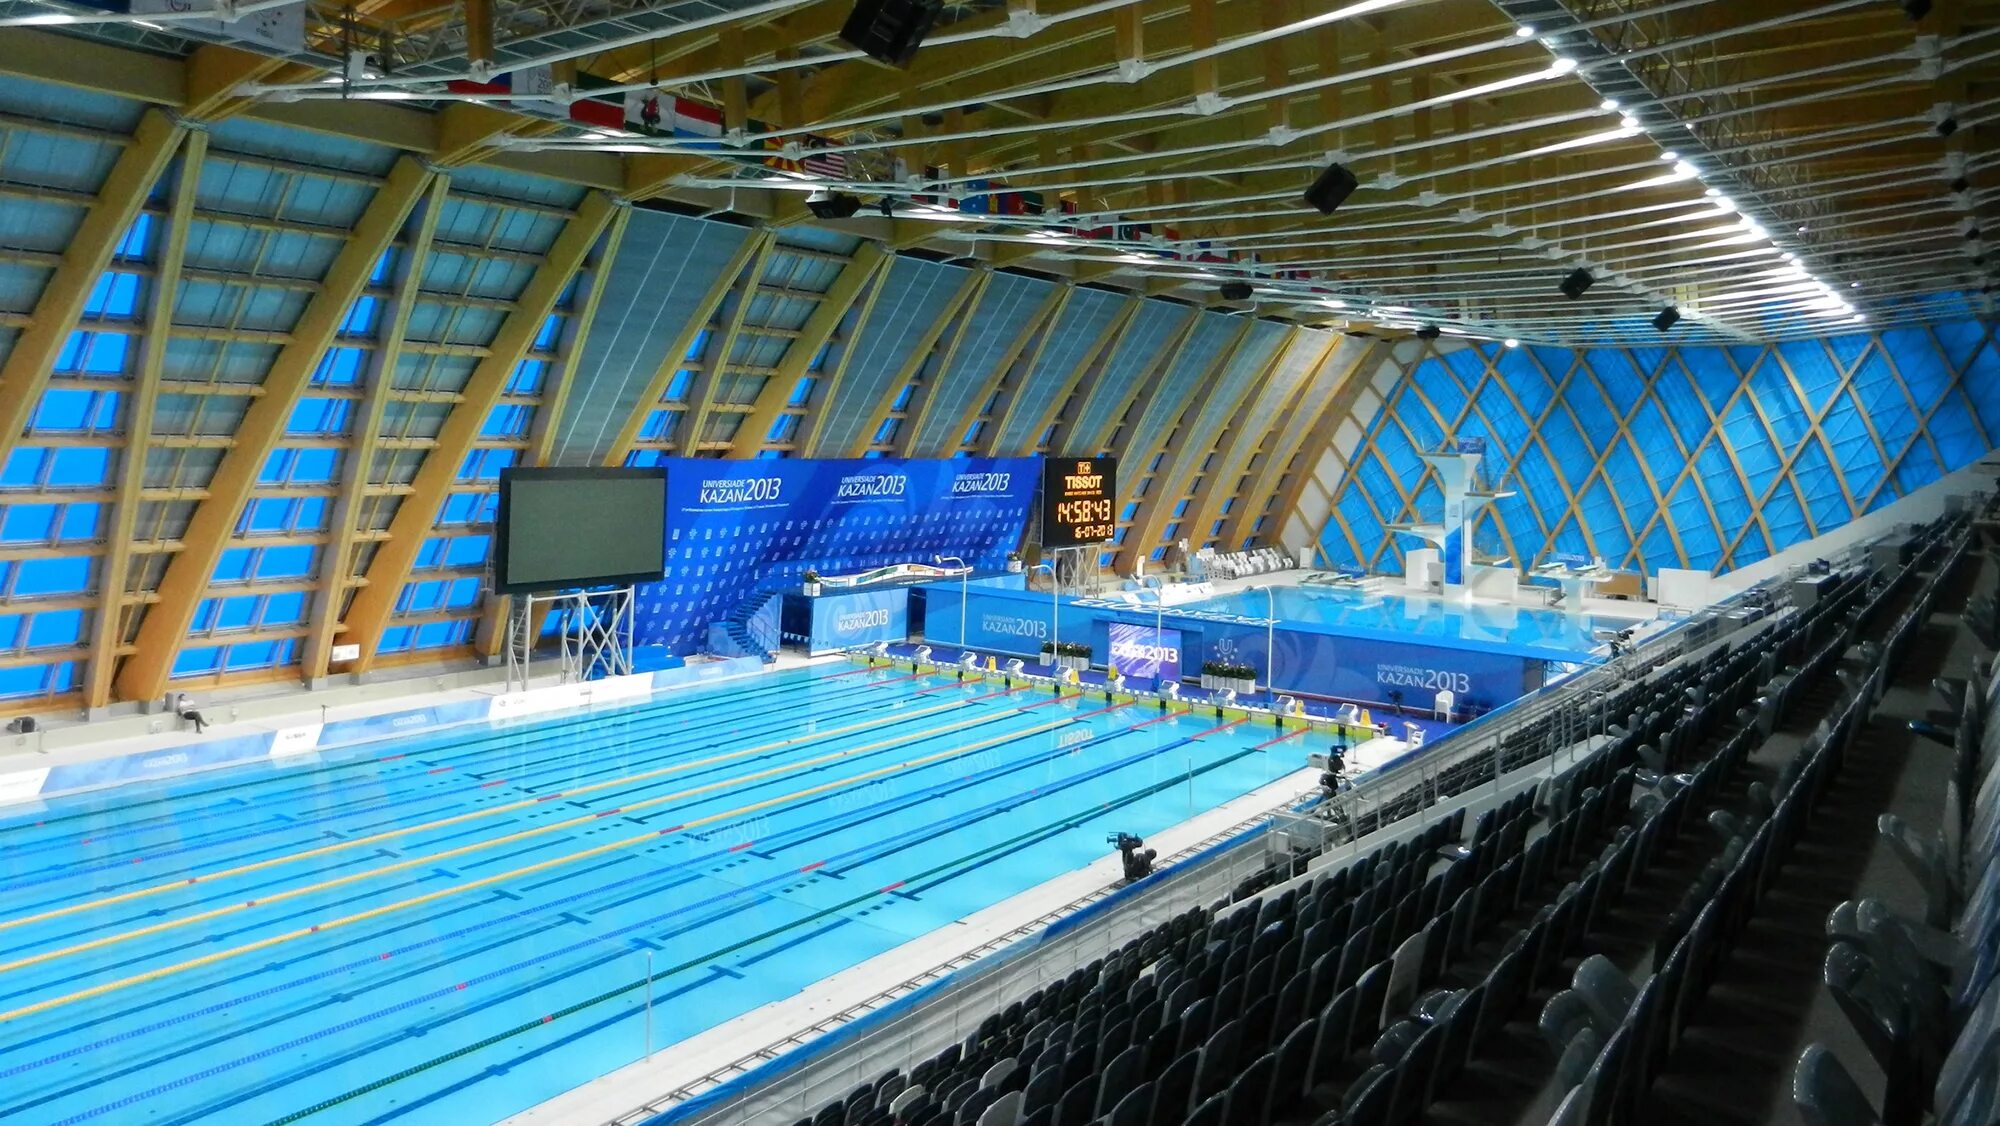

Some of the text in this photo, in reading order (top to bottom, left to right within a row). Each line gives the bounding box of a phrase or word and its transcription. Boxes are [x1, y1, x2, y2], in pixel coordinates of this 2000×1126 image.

[700, 477, 782, 503] KAZAN 2013
[703, 479, 745, 488] UNIVERSIADE
[838, 475, 907, 497] KAZAN 2013
[952, 473, 1010, 493] KAZAN 2013
[1065, 475, 1103, 489] TISSOT
[1058, 499, 1111, 523] 14:58:43
[838, 609, 889, 631] KAZAN 2013
[982, 618, 1047, 638] KAZAN 2013
[1377, 669, 1470, 693] KAZAN 2013
